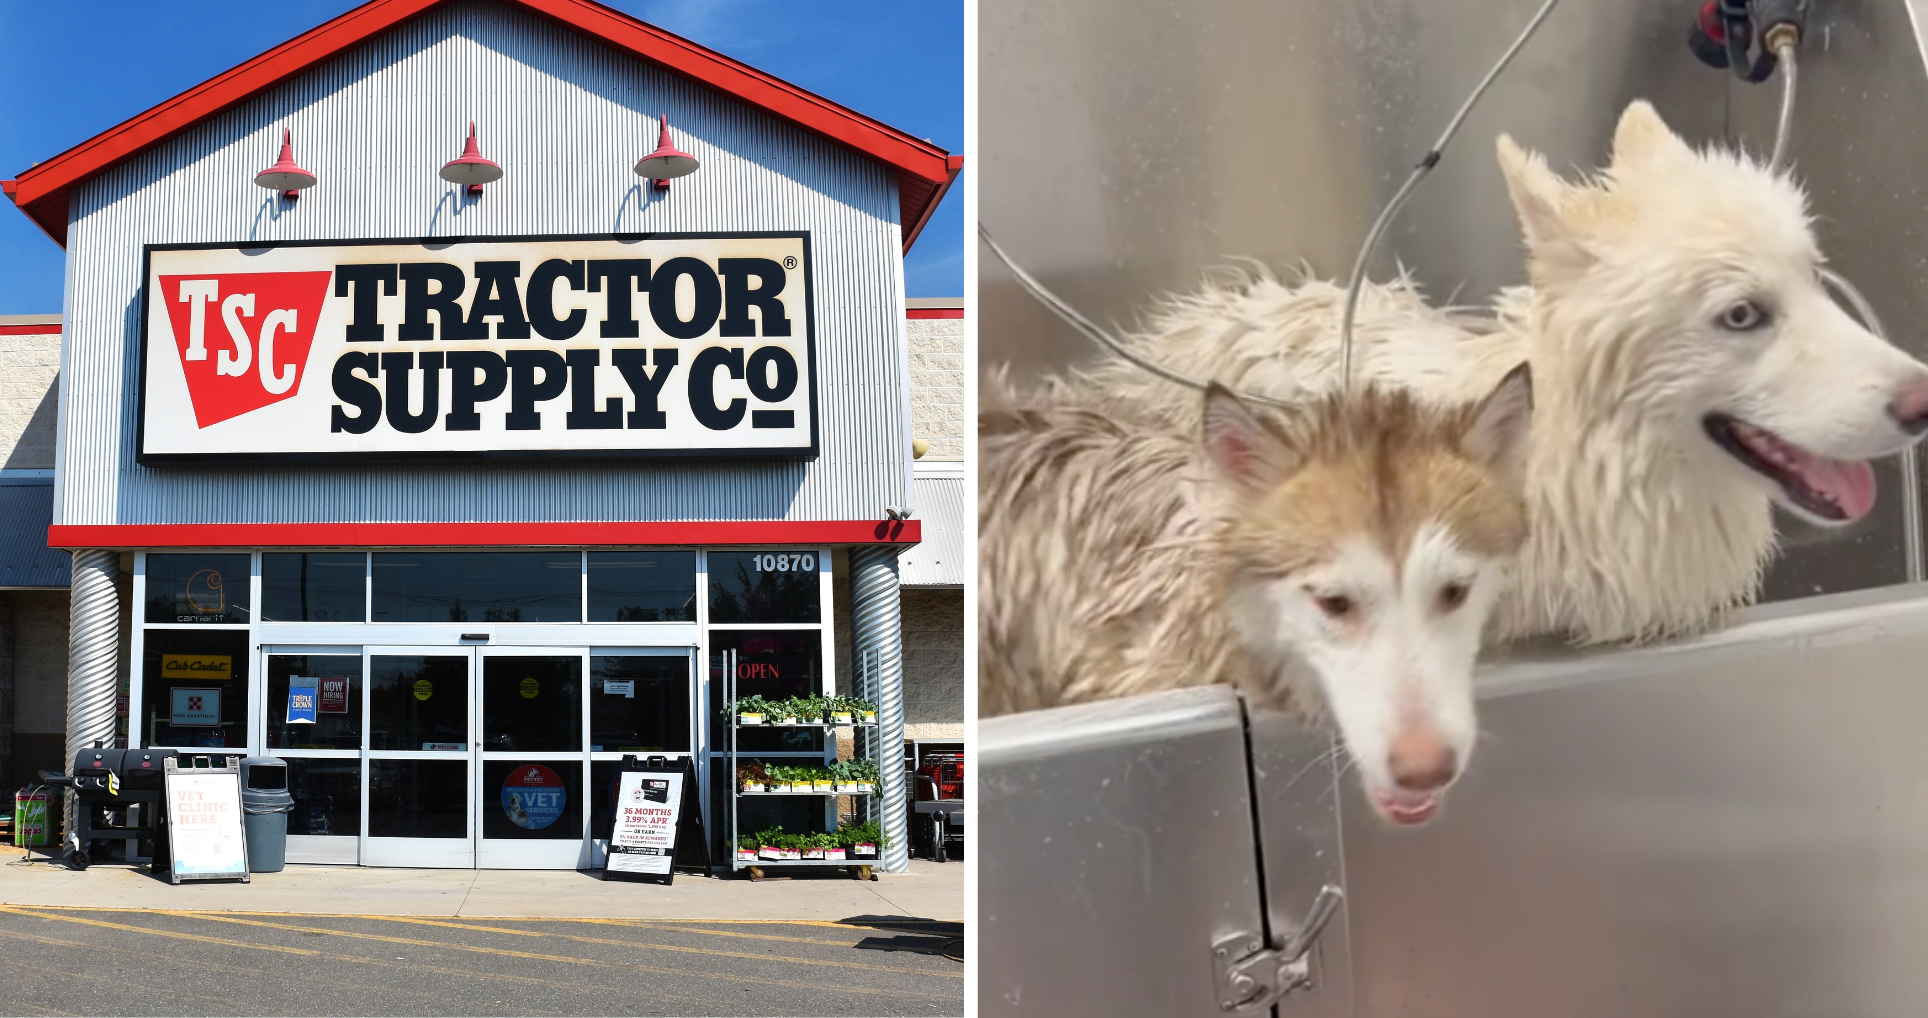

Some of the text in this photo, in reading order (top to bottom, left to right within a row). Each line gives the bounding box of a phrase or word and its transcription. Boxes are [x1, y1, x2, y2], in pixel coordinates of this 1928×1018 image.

[334, 256, 791, 342] TRACTOR
[179, 279, 297, 395] TSC
[330, 348, 679, 434] SUPPLY
[753, 554, 815, 572] 10870
[166, 661, 228, 672] Cub Cadet
[738, 662, 779, 679] OPEN
[323, 681, 344, 692] NOW
[323, 691, 344, 699] HIRING
[177, 791, 204, 801] VET
[523, 792, 561, 807] VET
[178, 802, 229, 813] CLINIC
[623, 807, 672, 816] 36 MONTHS
[179, 814, 218, 824] HERE
[625, 815, 648, 824] 3.99%
